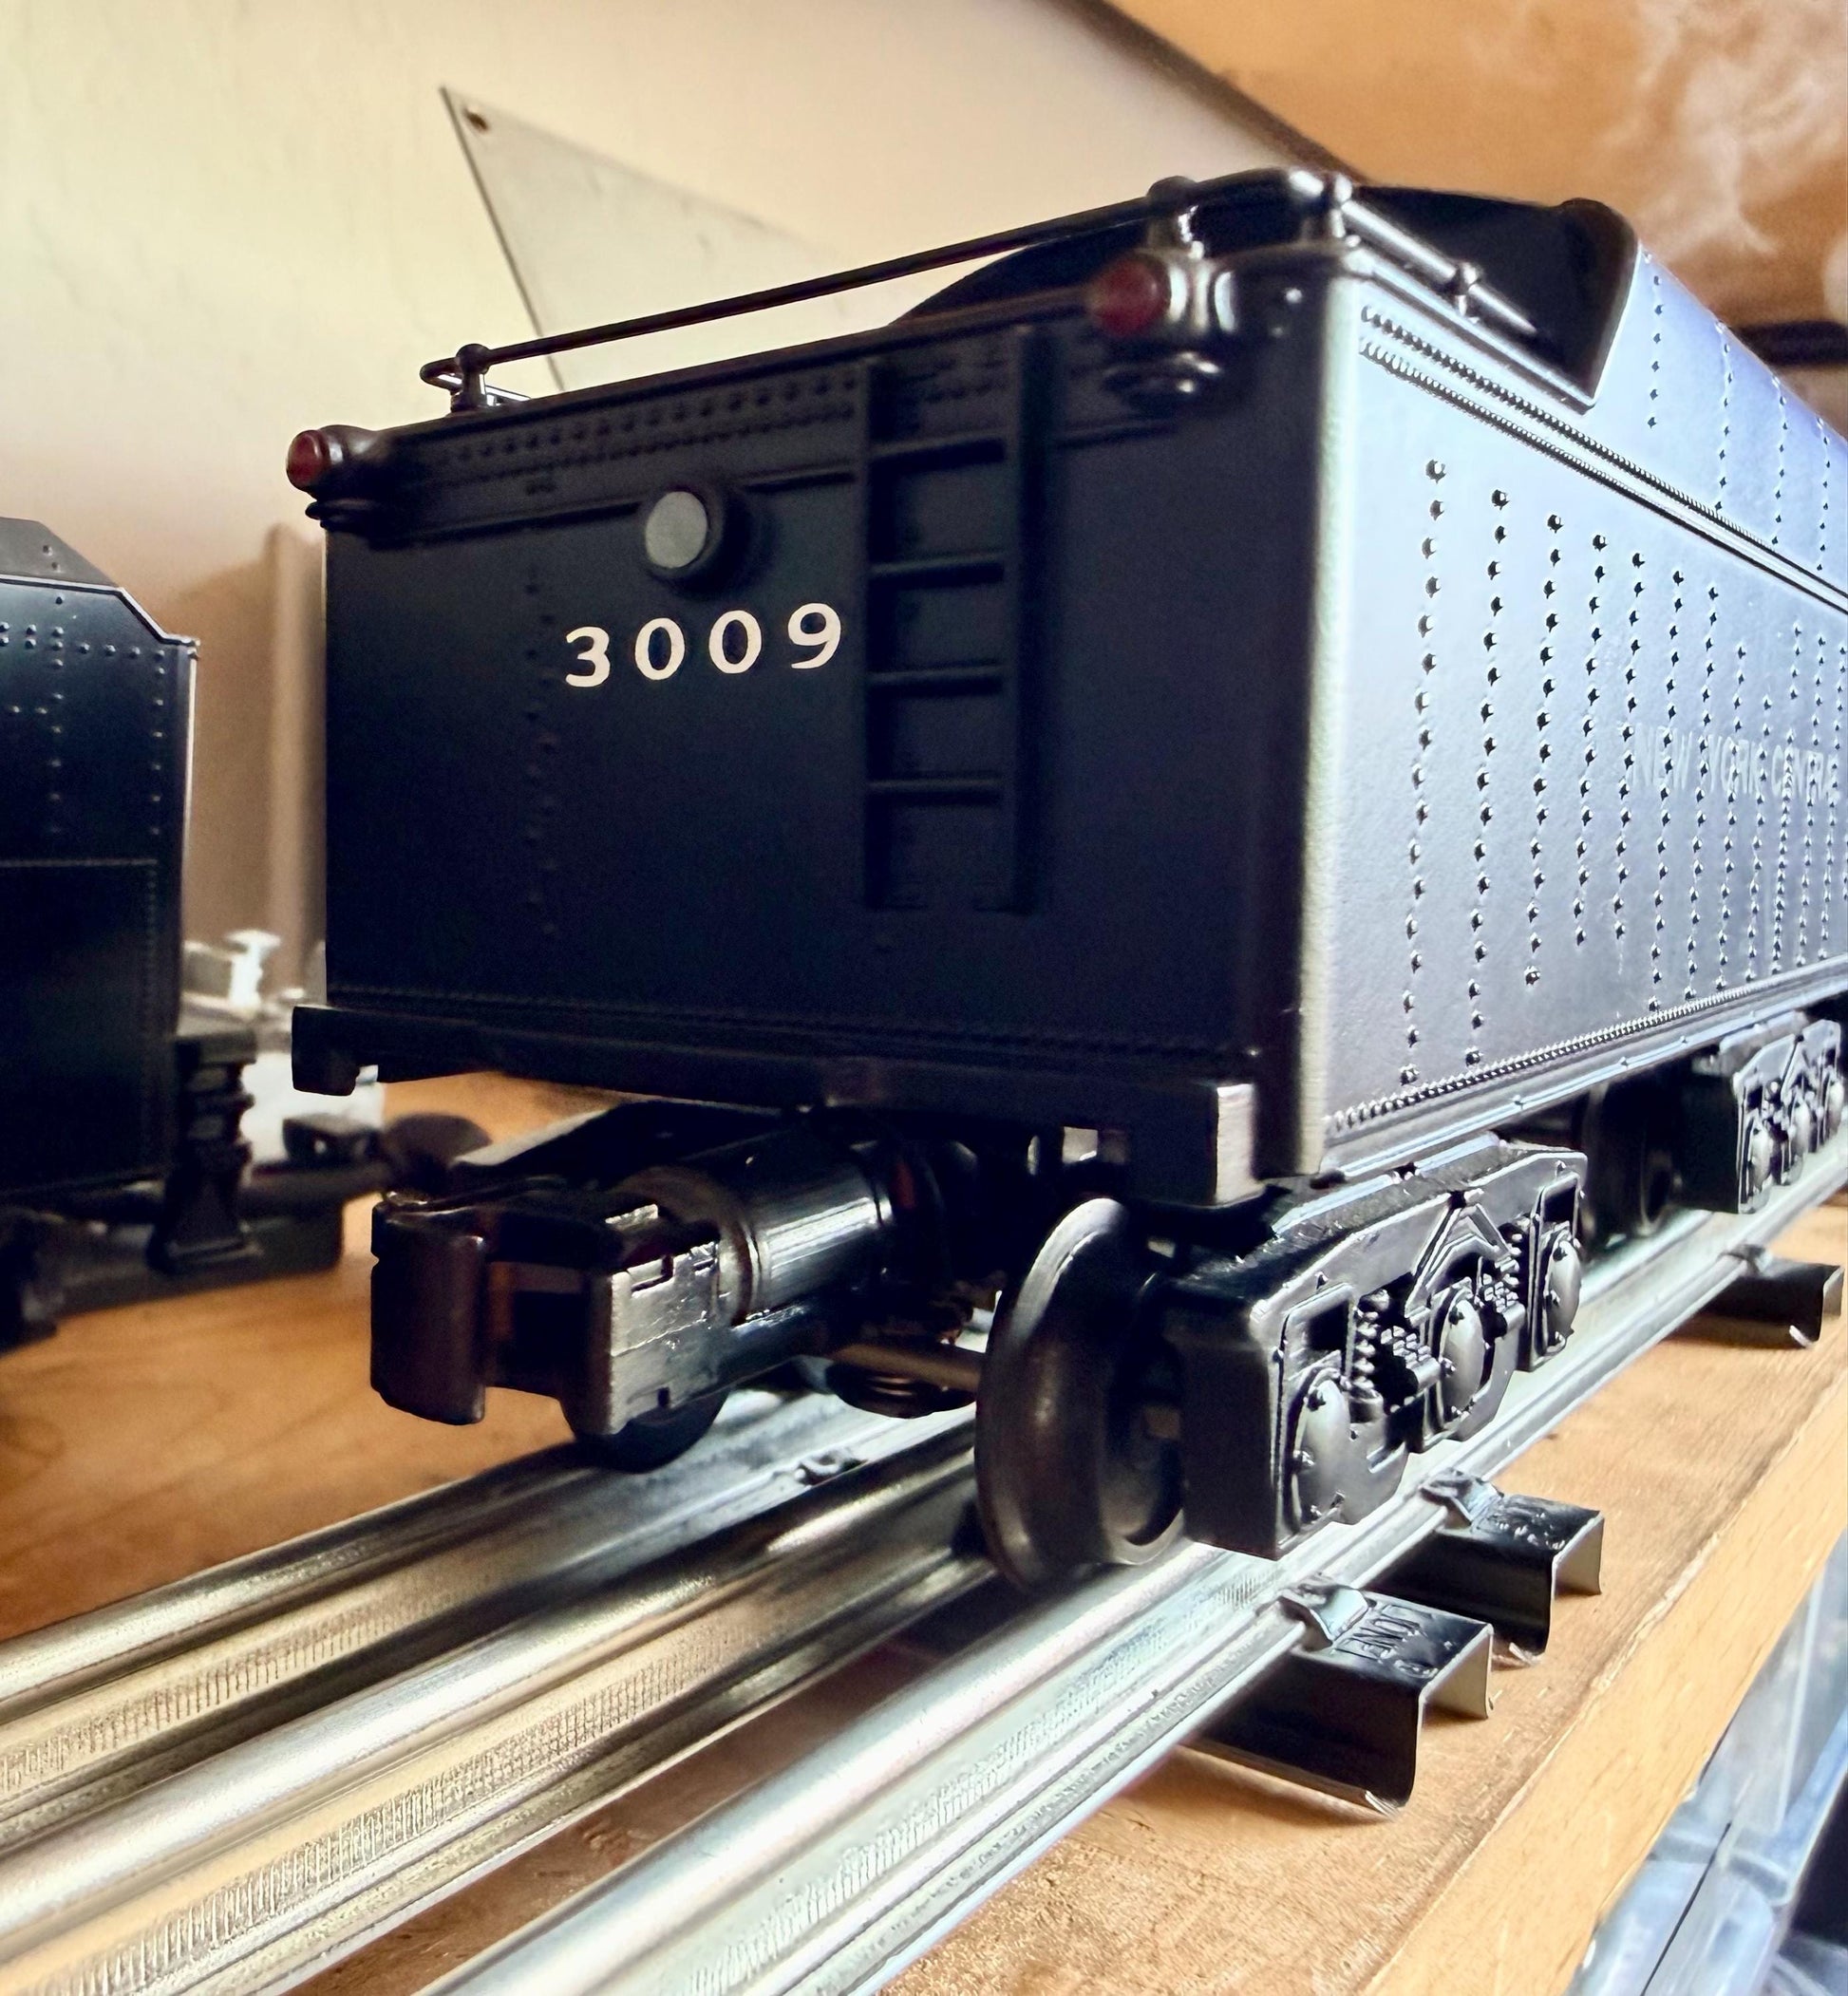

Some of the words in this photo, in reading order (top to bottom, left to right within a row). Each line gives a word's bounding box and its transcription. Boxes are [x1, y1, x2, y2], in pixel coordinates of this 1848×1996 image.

[565, 602, 841, 688] 3009
[1631, 722, 1694, 792] NEW
[1707, 734, 1764, 795] YORK
